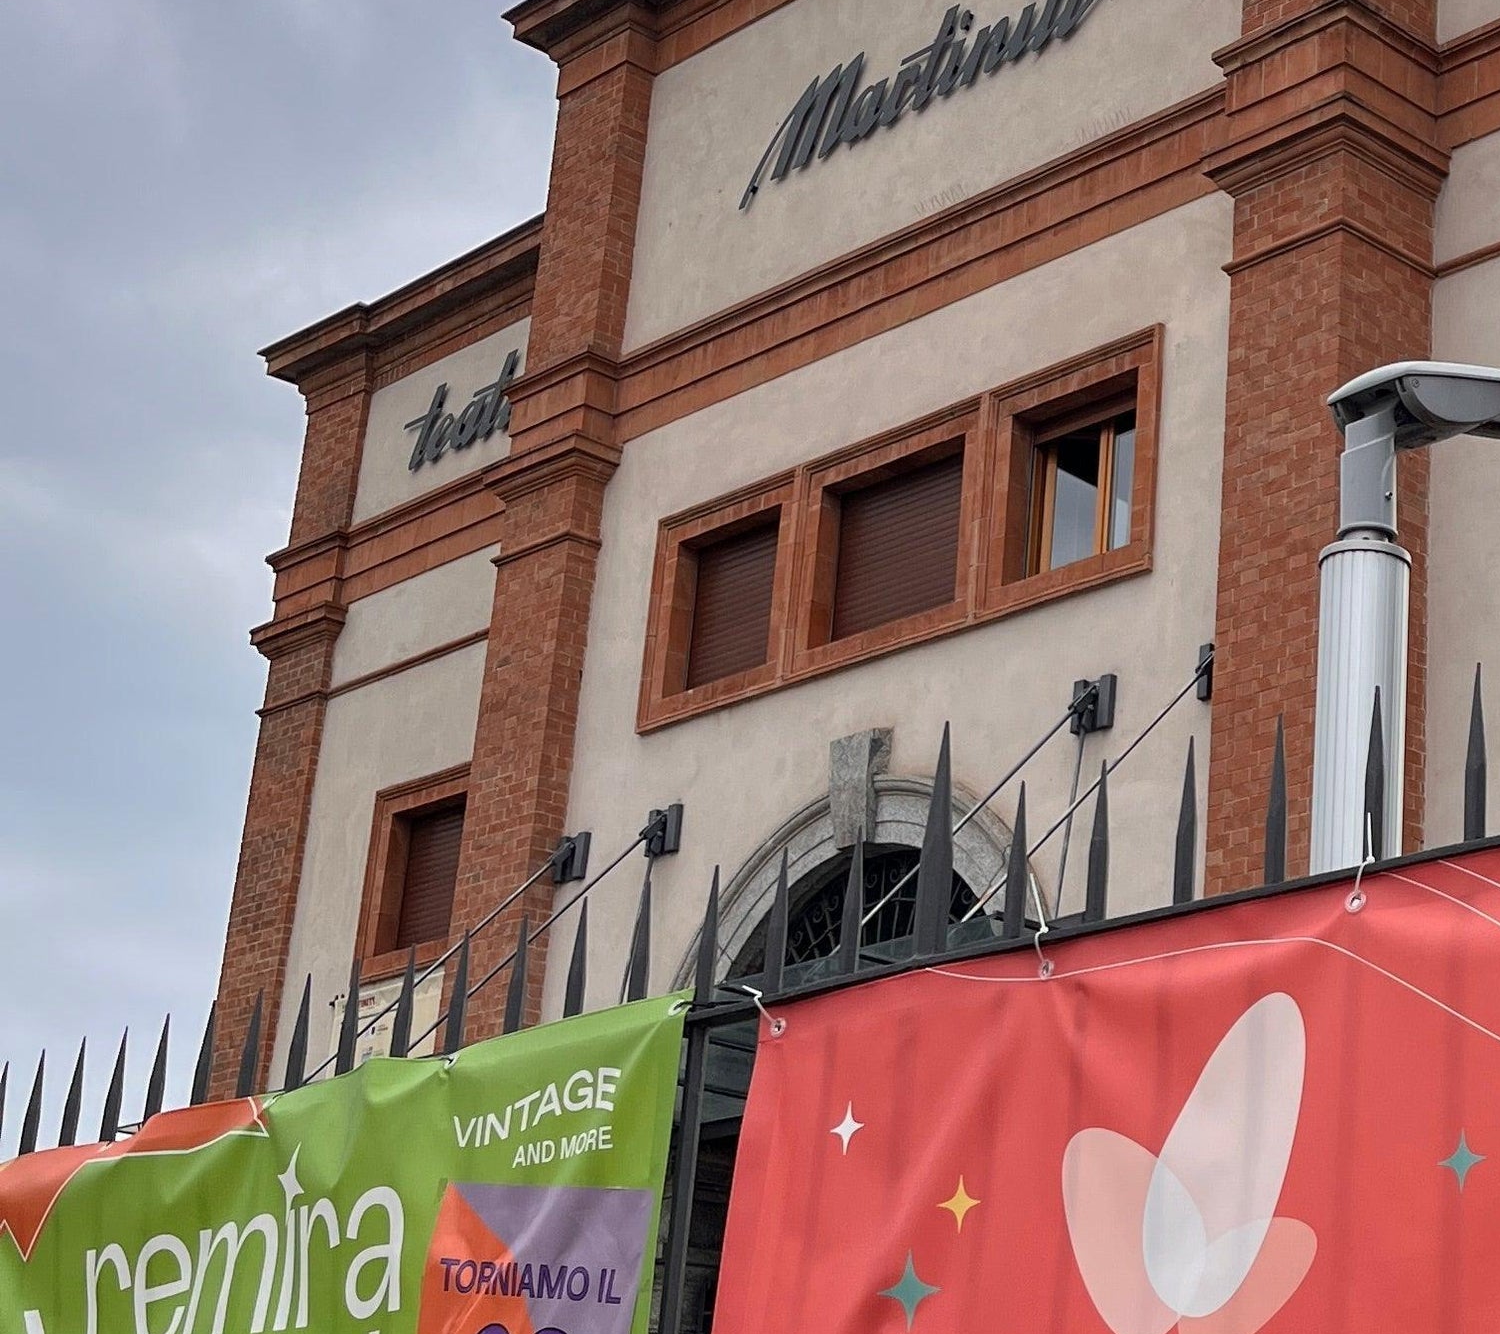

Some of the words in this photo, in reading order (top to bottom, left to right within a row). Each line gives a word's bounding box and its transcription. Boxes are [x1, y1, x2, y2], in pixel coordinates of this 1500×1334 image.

[404, 349, 519, 470] teat
[453, 1067, 622, 1149] VINTAGE
[512, 1140, 555, 1169] AND
[560, 1125, 614, 1157] MORE
[440, 1258, 590, 1303] TORNIAMO
[598, 1278, 622, 1305] IL
